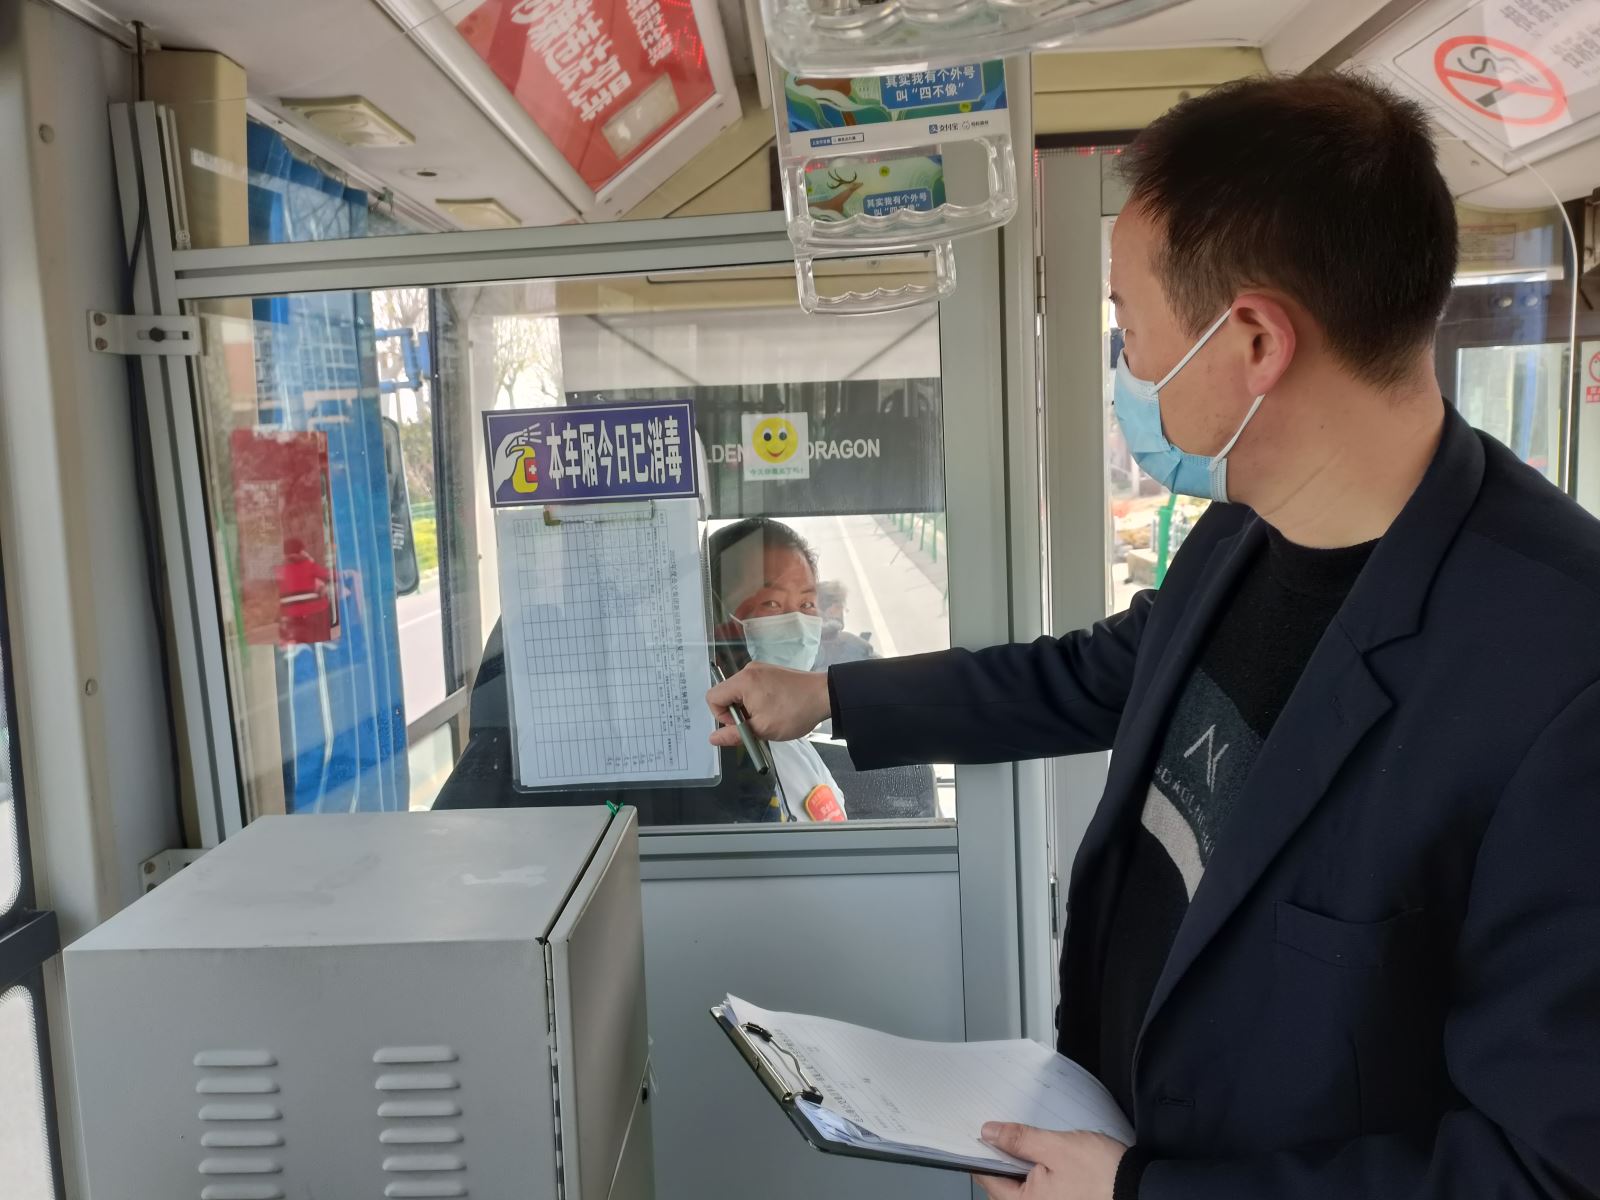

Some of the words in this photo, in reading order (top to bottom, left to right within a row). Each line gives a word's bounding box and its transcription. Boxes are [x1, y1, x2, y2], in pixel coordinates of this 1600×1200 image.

[546, 415, 682, 490] 本车厢今日已消毒
